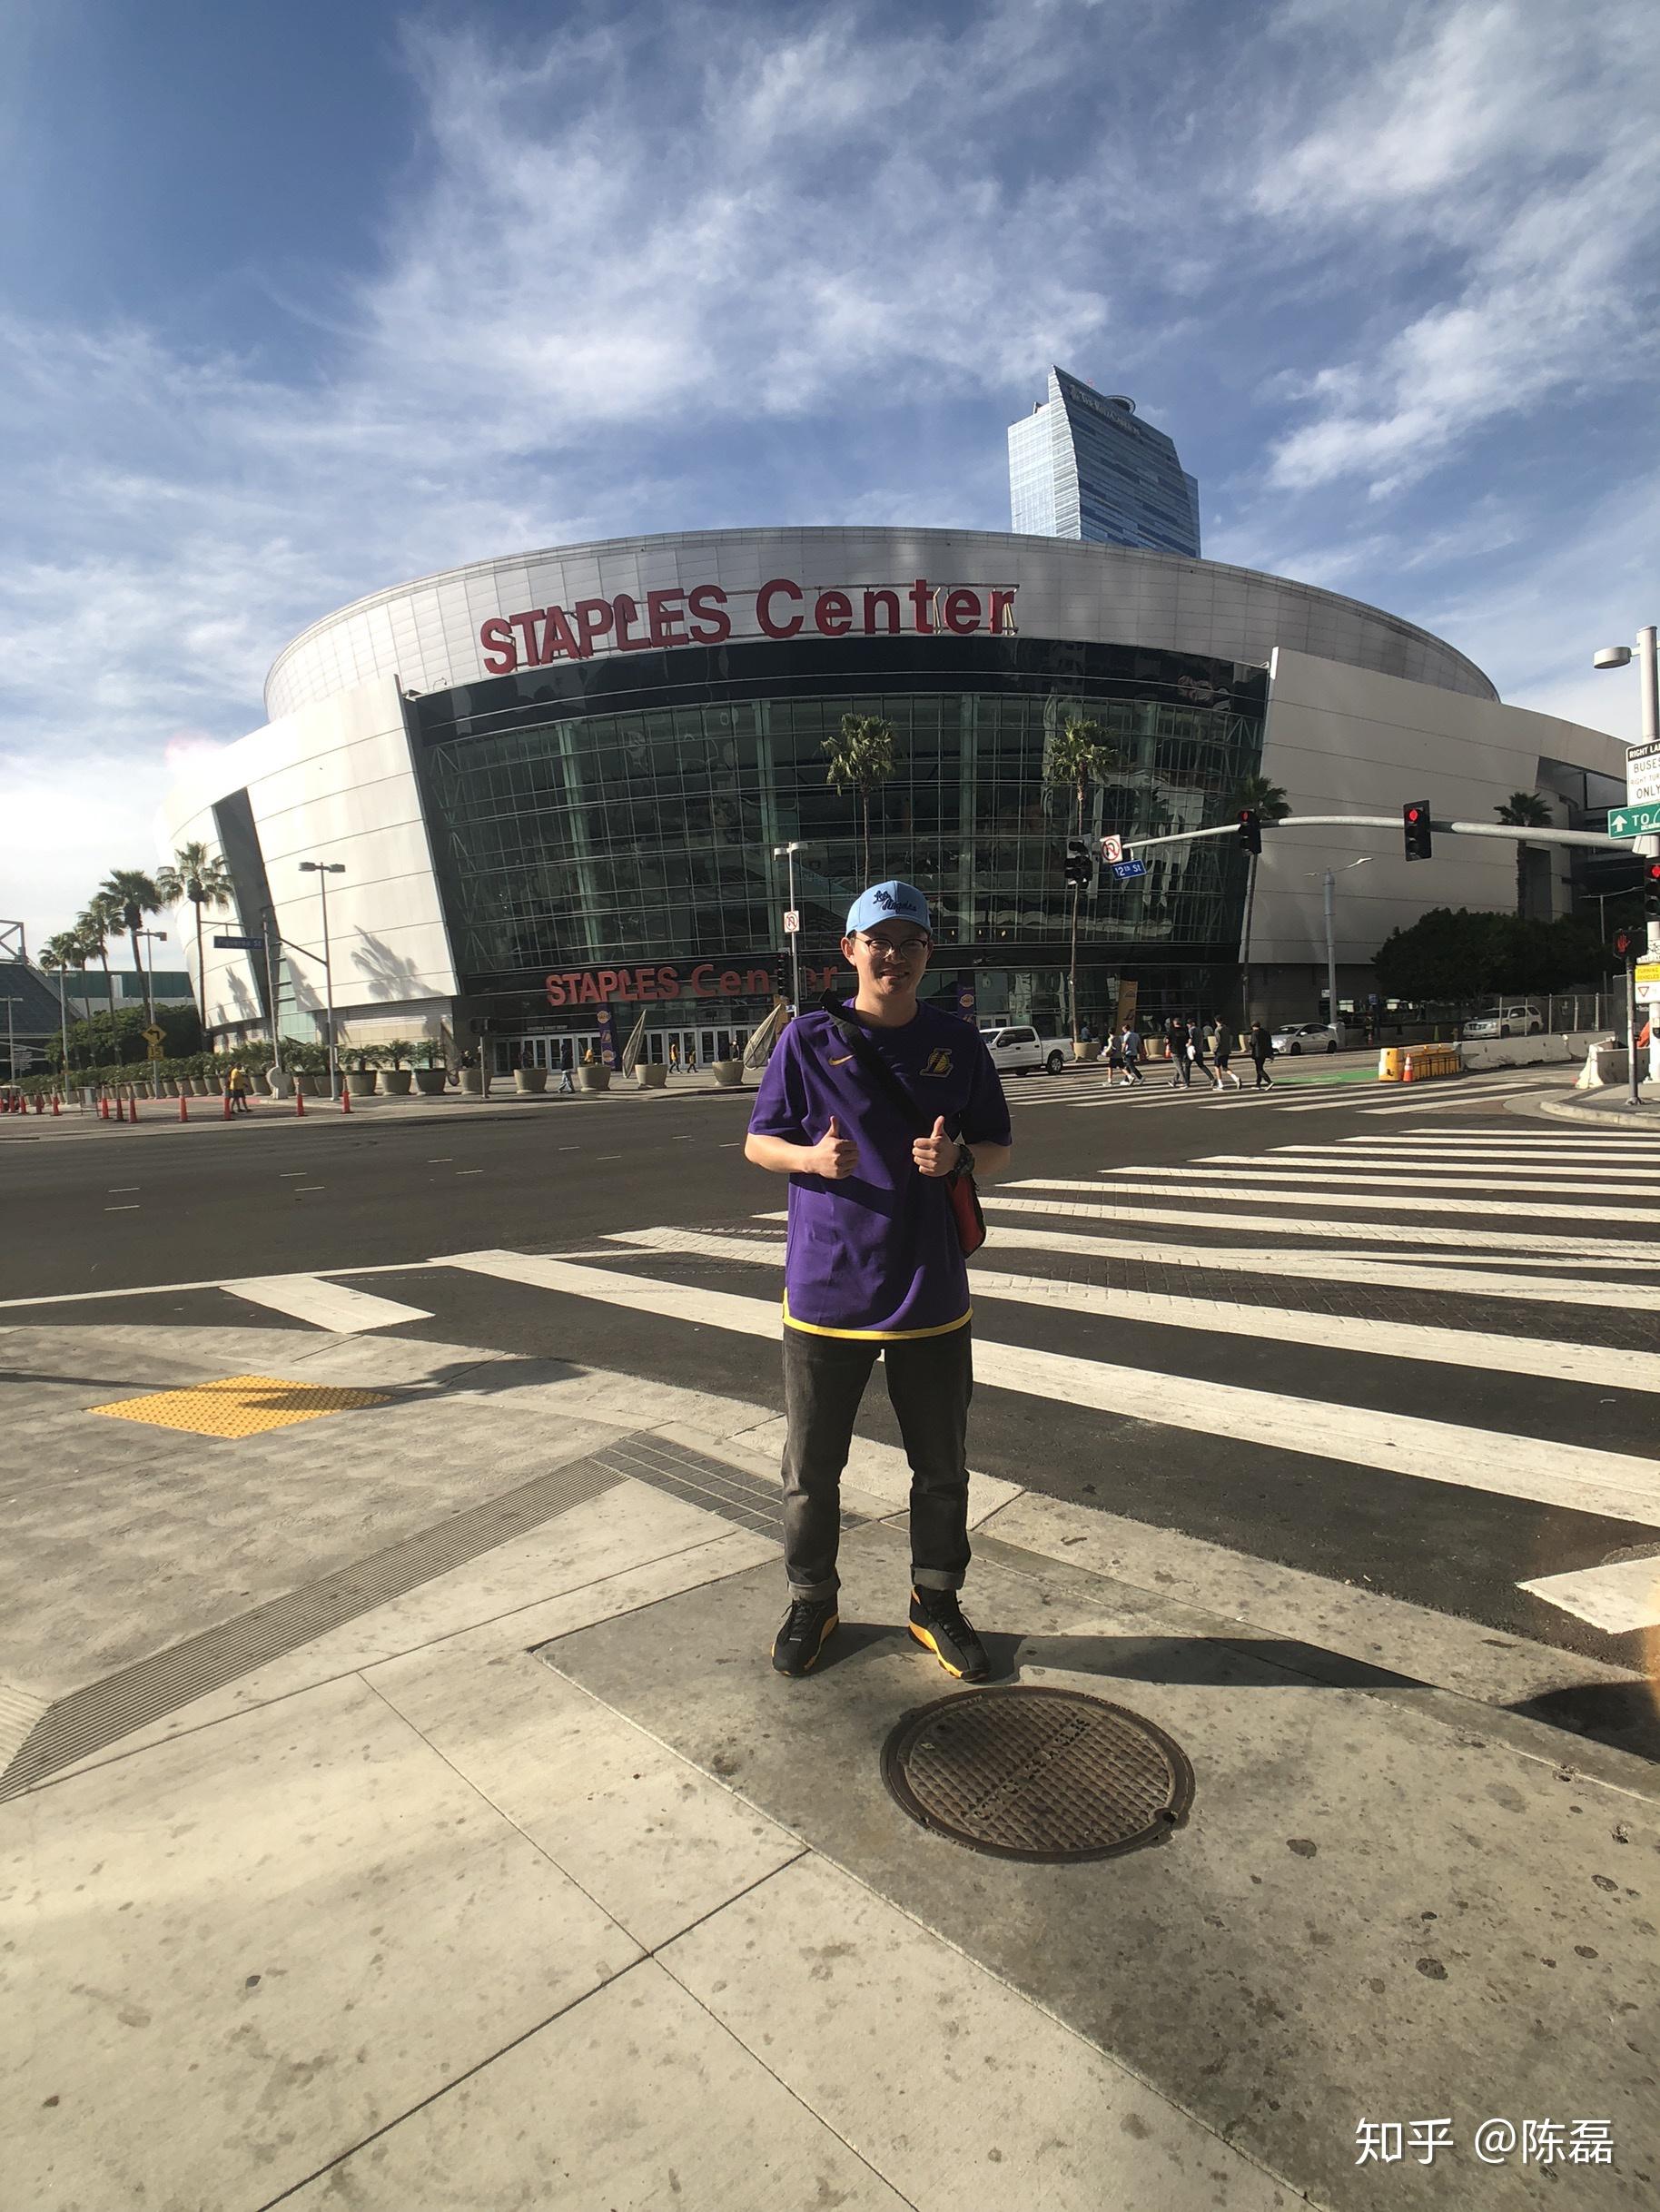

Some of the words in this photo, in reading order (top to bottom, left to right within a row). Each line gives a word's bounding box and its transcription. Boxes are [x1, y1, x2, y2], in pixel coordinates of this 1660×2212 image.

[480, 584, 731, 675] STAPLES
[756, 578, 1015, 639] Center
[1629, 746, 1649, 759] RIGHT
[1649, 742, 1660, 754] LA
[1636, 785, 1660, 799] ONLY
[1632, 814, 1650, 826] TO
[1132, 864, 1141, 873] St
[546, 966, 680, 1007] STAPLES
[691, 964, 837, 997] Cener
[151, 1048, 161, 1056] 15
